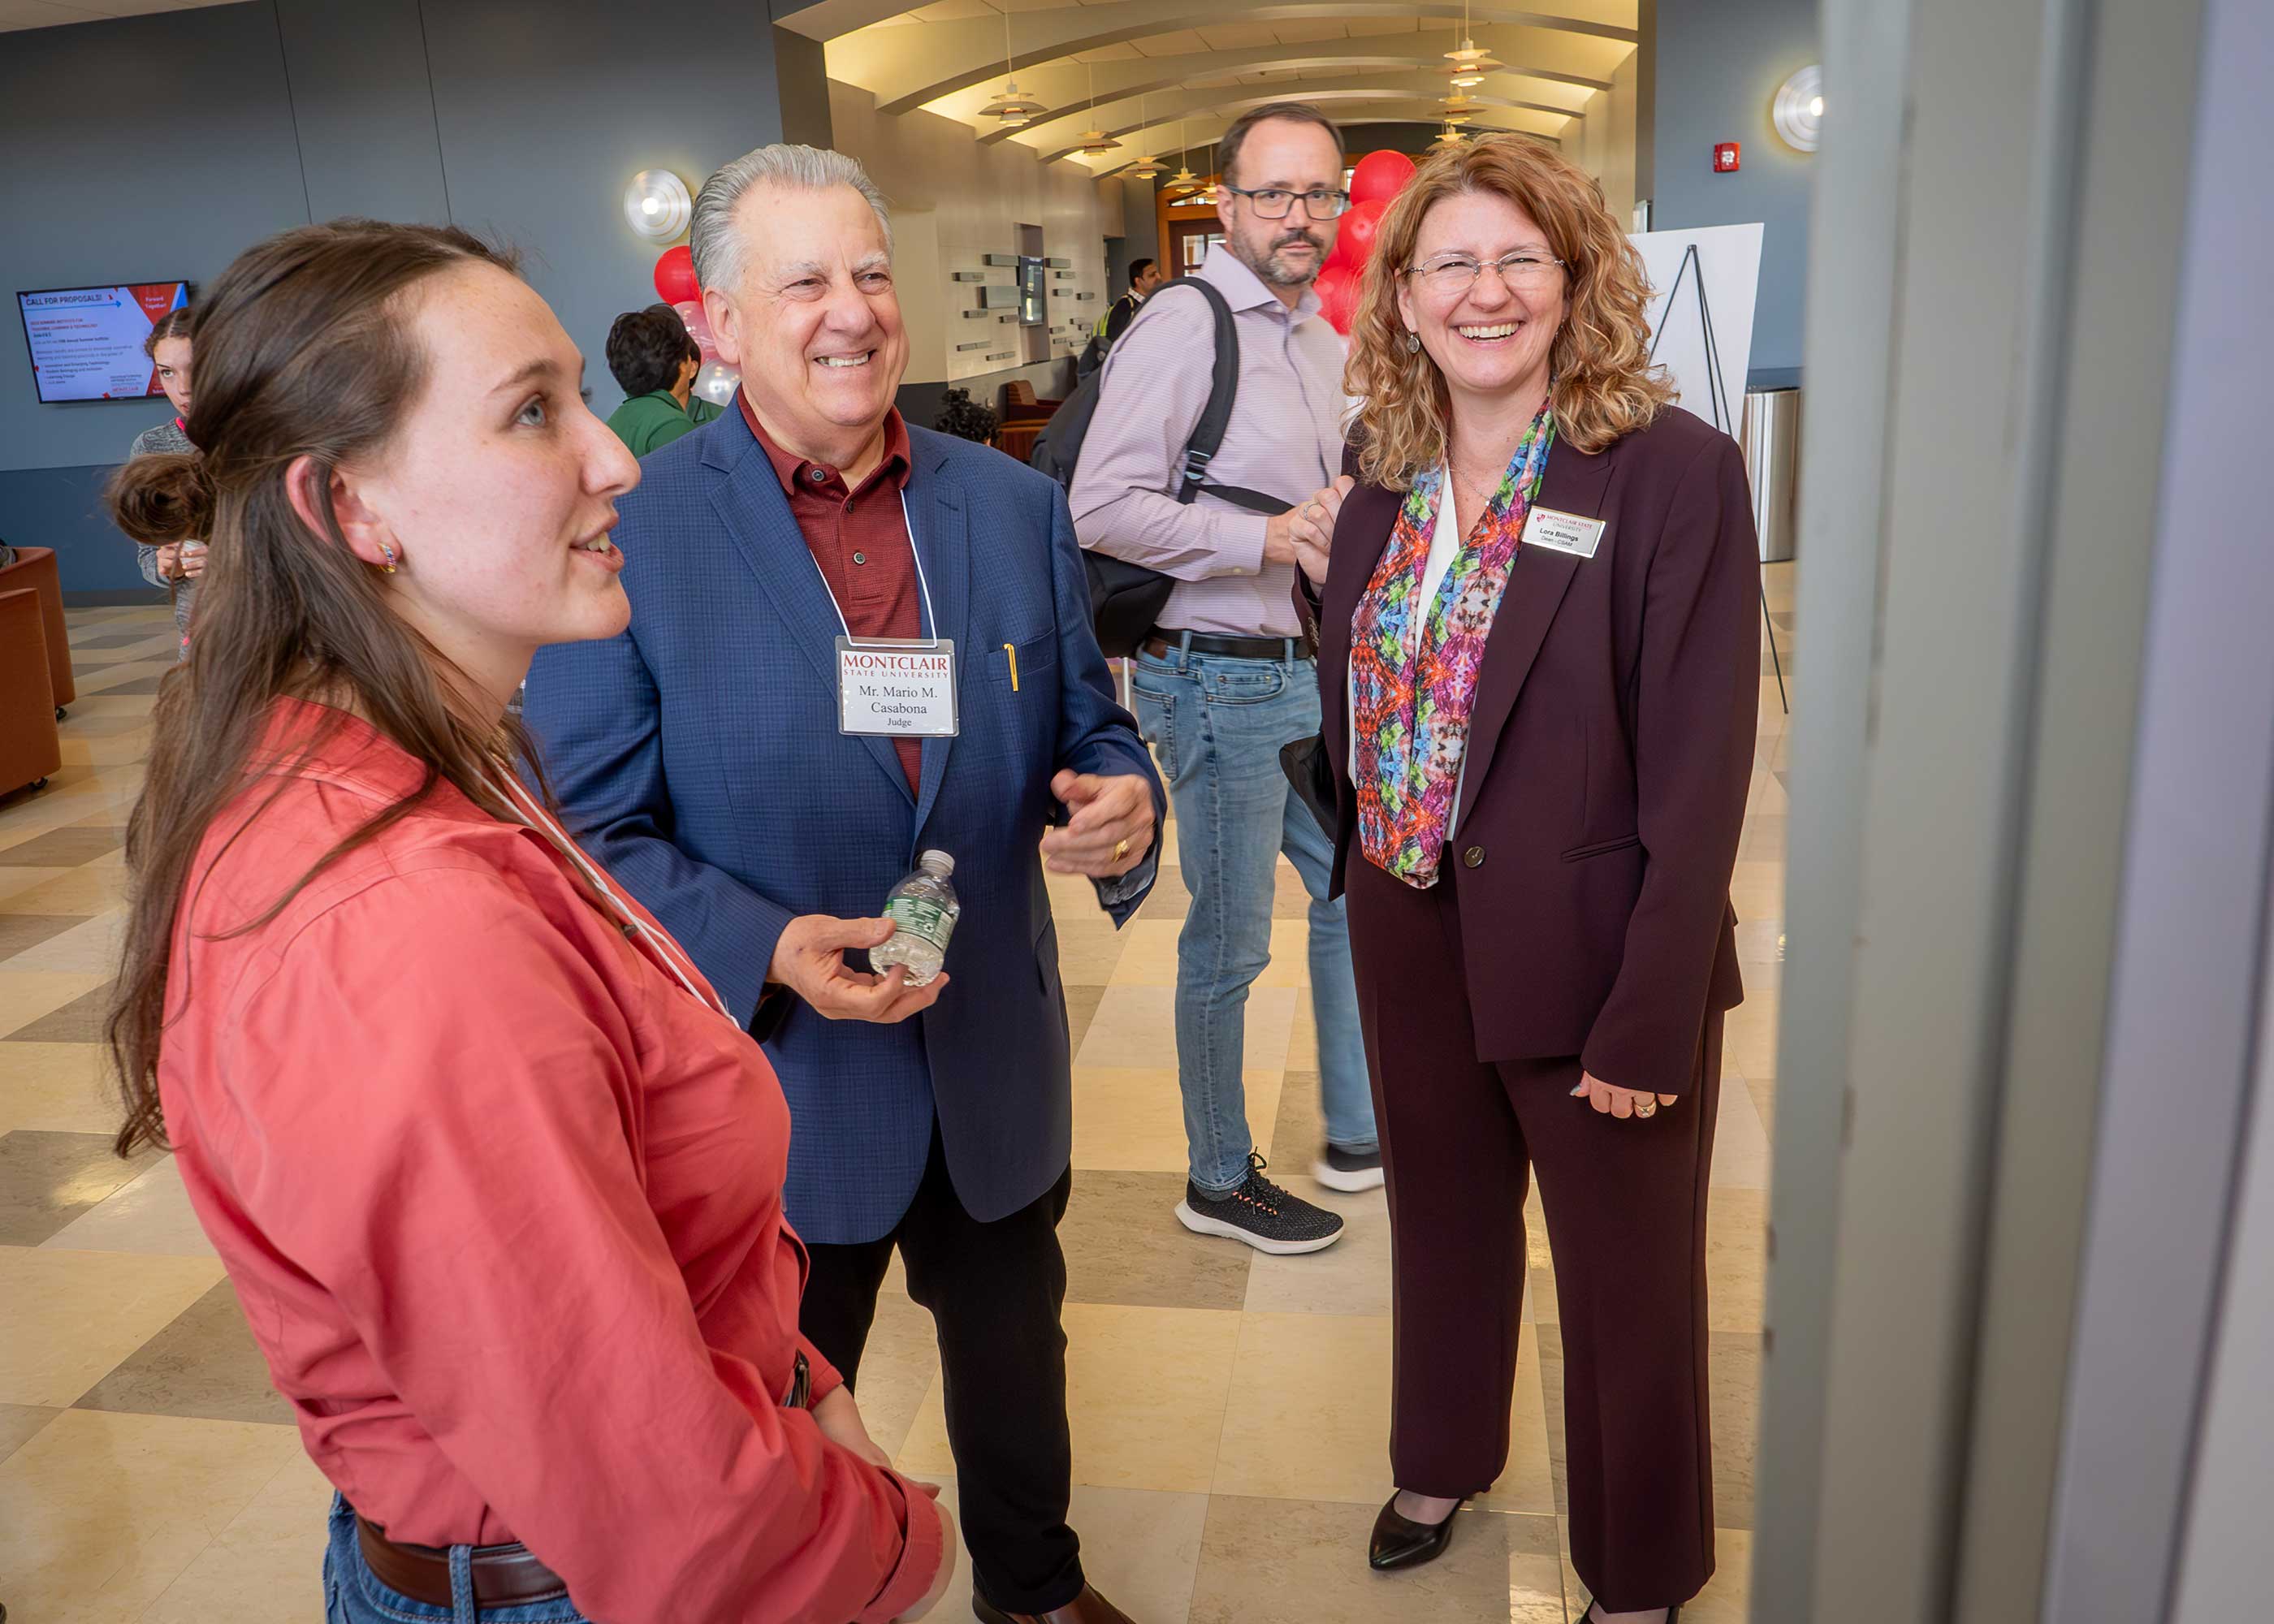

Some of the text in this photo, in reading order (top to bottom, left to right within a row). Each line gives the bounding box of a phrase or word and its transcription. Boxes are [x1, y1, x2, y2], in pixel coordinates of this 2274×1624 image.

[45, 296, 58, 304] FOR
[1552, 522, 1581, 533] UNIVERSITY
[1539, 528, 1579, 542] Lora Billings
[844, 654, 948, 671] MONTCLAIR
[844, 669, 949, 679] STATE UNIVERSITY
[858, 685, 938, 698] Mr. Mario M.
[871, 702, 927, 715] Casabona
[887, 718, 912, 728] Judge
